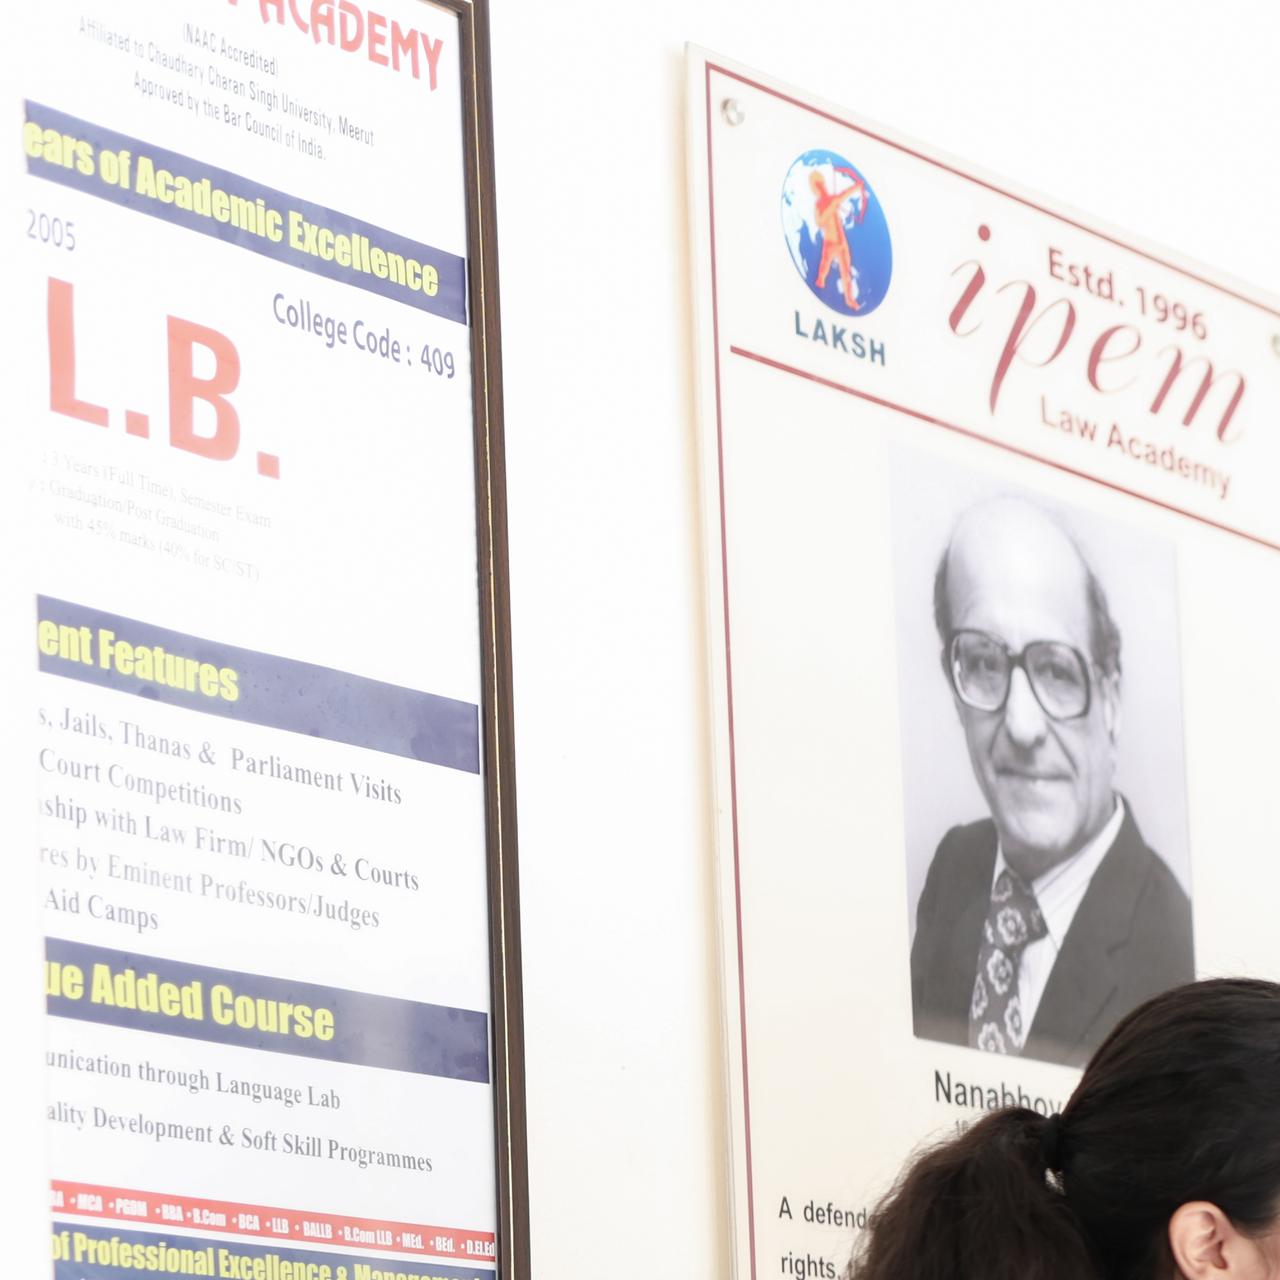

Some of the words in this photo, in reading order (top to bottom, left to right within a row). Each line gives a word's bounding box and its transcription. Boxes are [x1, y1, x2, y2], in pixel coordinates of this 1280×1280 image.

[79, 16, 130, 53] Affiliated
[134, 41, 145, 58] to
[148, 42, 204, 81] Chaudhary
[209, 65, 246, 97] Charan
[249, 80, 280, 112] Singh
[338, 115, 375, 147] Meerut
[134, 70, 184, 107] Approved
[187, 91, 200, 118] by
[203, 99, 220, 120] the
[224, 103, 242, 127] Bar
[245, 111, 283, 145] Council
[286, 129, 295, 149] of
[26, 209, 77, 252] 2005
[99, 149, 132, 190] of
[136, 155, 284, 243] Academic
[288, 210, 440, 296] Excellence
[1047, 245, 1125, 307] Estd.
[1136, 285, 1208, 341] 1996
[272, 292, 348, 348] College
[420, 344, 457, 380] 409
[793, 309, 886, 368] LAKSH
[948, 223, 1247, 446] ipem
[1040, 394, 1098, 442] Law
[1106, 422, 1232, 501] Academy
[63, 453, 100, 478] Years
[179, 487, 233, 518] Semester
[236, 504, 272, 529] Exam
[155, 508, 220, 543] Graduation
[54, 511, 83, 531] with
[119, 527, 156, 552] marks
[38, 619, 93, 665] ent
[98, 628, 240, 703] Features
[39, 748, 101, 784] Court
[108, 763, 243, 815] Competitions
[119, 720, 192, 761] Thanas
[198, 741, 217, 766] &
[231, 747, 344, 792] Parliament
[350, 772, 403, 805] Visits
[95, 807, 137, 836] with
[145, 815, 188, 846] Law
[261, 839, 324, 873] NGOs
[331, 853, 348, 877] &
[354, 857, 420, 892] Courts
[44, 888, 81, 915] Aid
[88, 893, 159, 934] Camps
[76, 847, 101, 880] by
[108, 854, 193, 894] Eminent
[201, 872, 381, 931] Professors/Judges
[91, 963, 204, 1021] Added
[210, 984, 335, 1041] Course
[138, 1060, 210, 1095] through
[217, 1072, 303, 1107] Language
[308, 1086, 341, 1110] Lab
[93, 1105, 213, 1144] Development
[218, 1124, 235, 1147] &
[241, 1127, 279, 1152] Soft
[282, 1132, 323, 1159] Skill
[328, 1139, 433, 1173] Programmes
[238, 1213, 260, 1231] BCA
[272, 1217, 289, 1234] LLB
[303, 1220, 333, 1239] BALLB
[344, 1226, 375, 1244] B.Com
[377, 1229, 393, 1246] LLB
[779, 1196, 793, 1220] A
[51, 1231, 71, 1261] of
[73, 1232, 215, 1277] Professional
